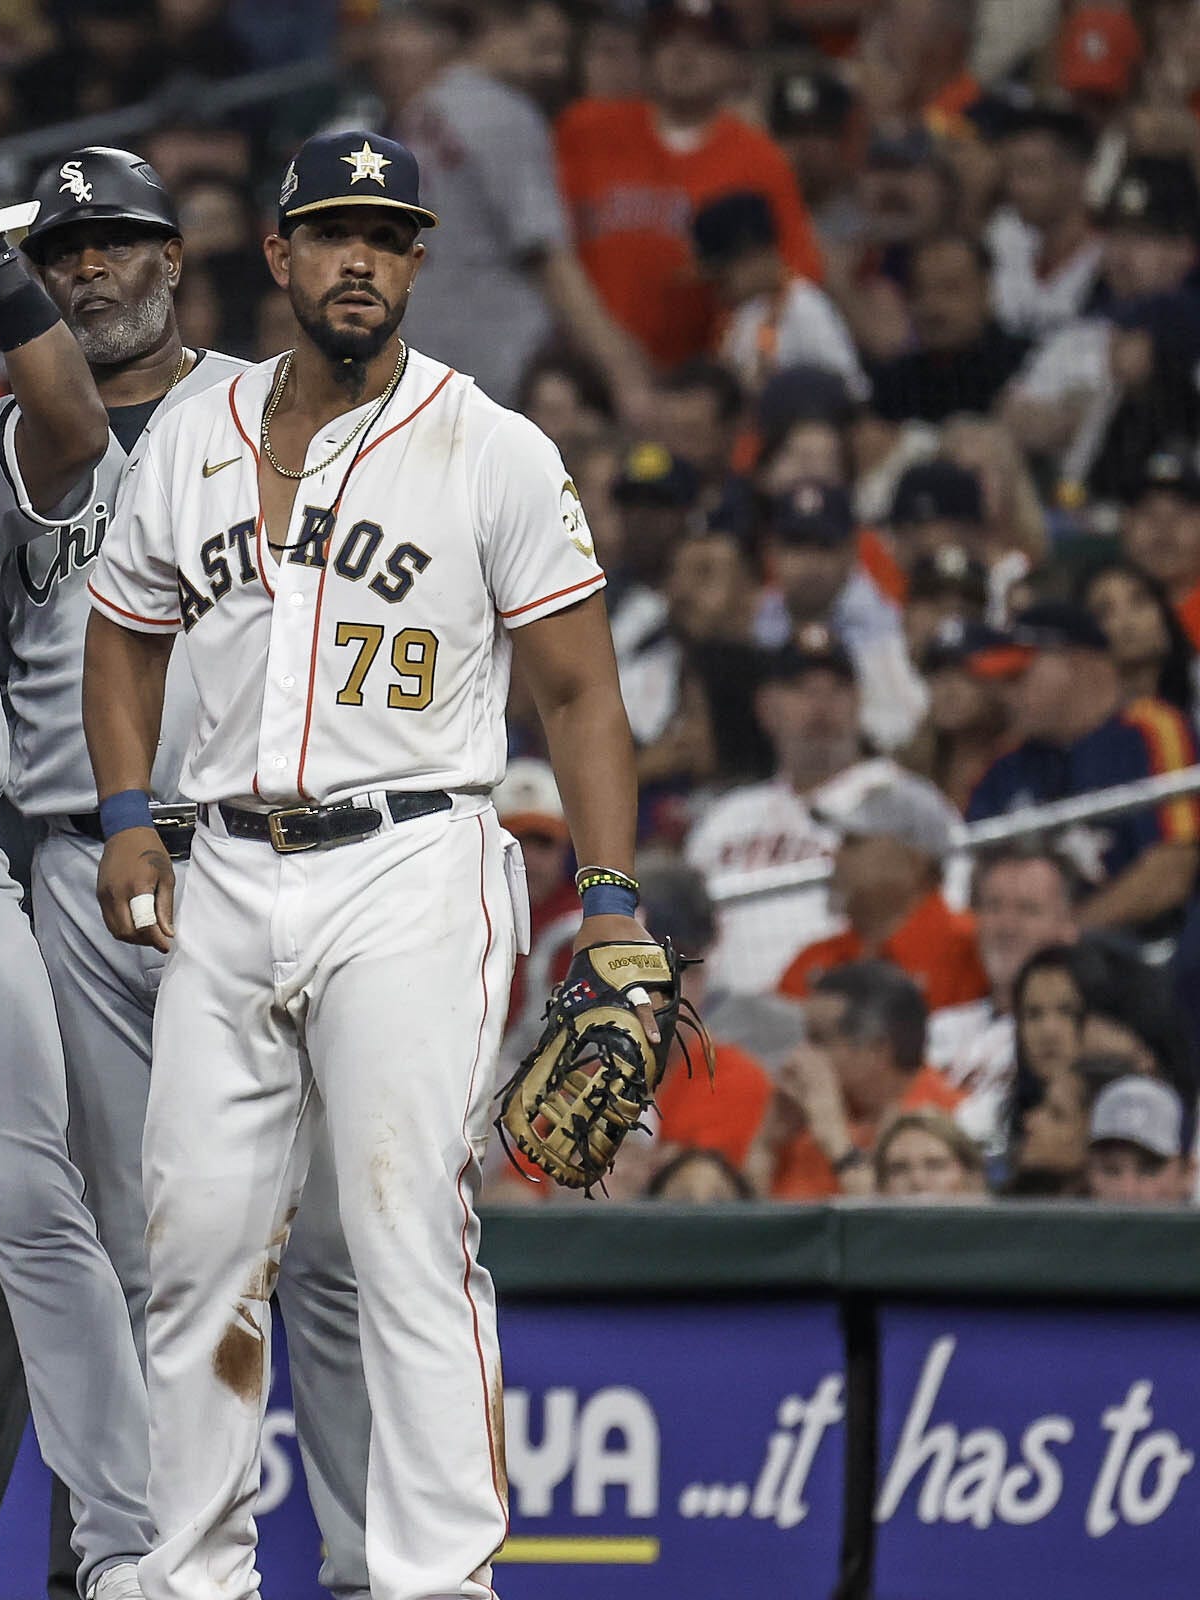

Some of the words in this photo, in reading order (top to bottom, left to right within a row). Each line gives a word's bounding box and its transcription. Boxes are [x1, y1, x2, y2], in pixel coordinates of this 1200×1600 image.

[59, 161, 93, 203] Sox
[176, 504, 433, 635] ASTROS
[334, 621, 440, 711] 79
[503, 1387, 660, 1518] YA
[872, 1334, 1074, 1530] has
[1086, 1378, 1194, 1538] to
